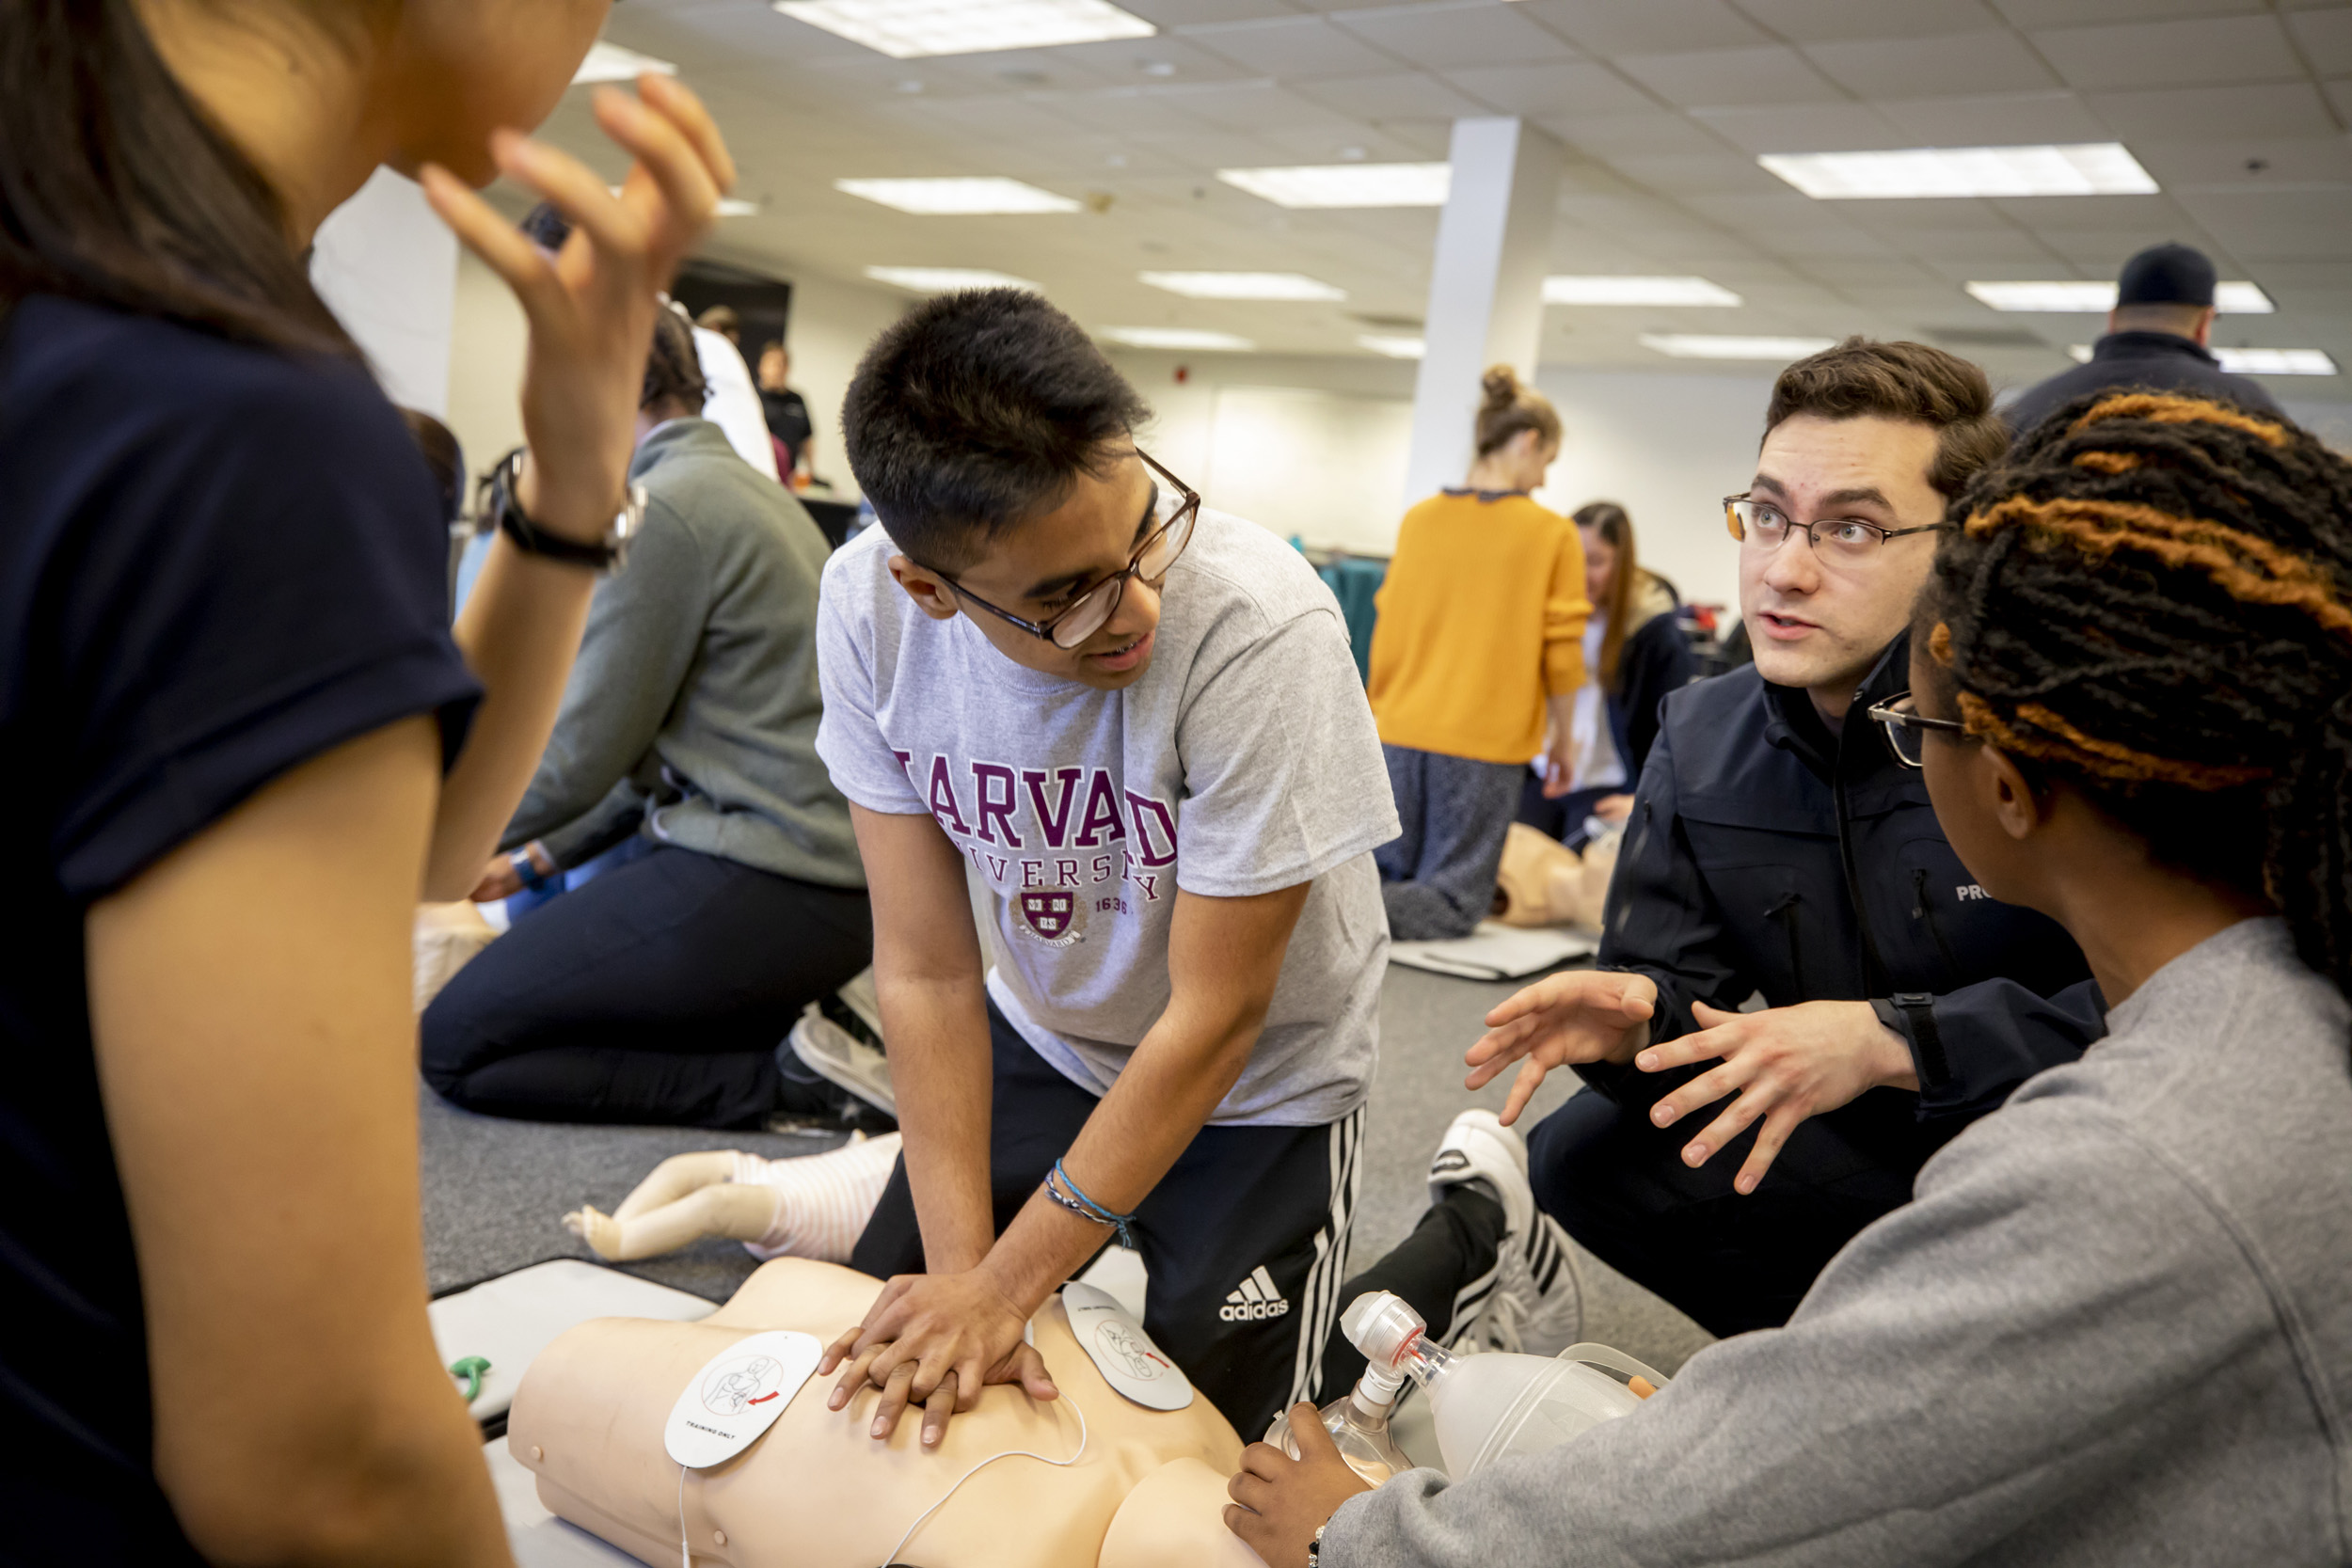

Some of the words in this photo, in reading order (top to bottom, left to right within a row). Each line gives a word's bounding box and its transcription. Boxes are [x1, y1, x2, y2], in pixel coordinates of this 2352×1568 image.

[892, 749, 1178, 868] ARVAD
[1096, 897, 1127, 914] 1636
[1219, 1299, 1289, 1322] adidas
[686, 1420, 717, 1434] TRAINING
[718, 1430, 736, 1440] ONLY
